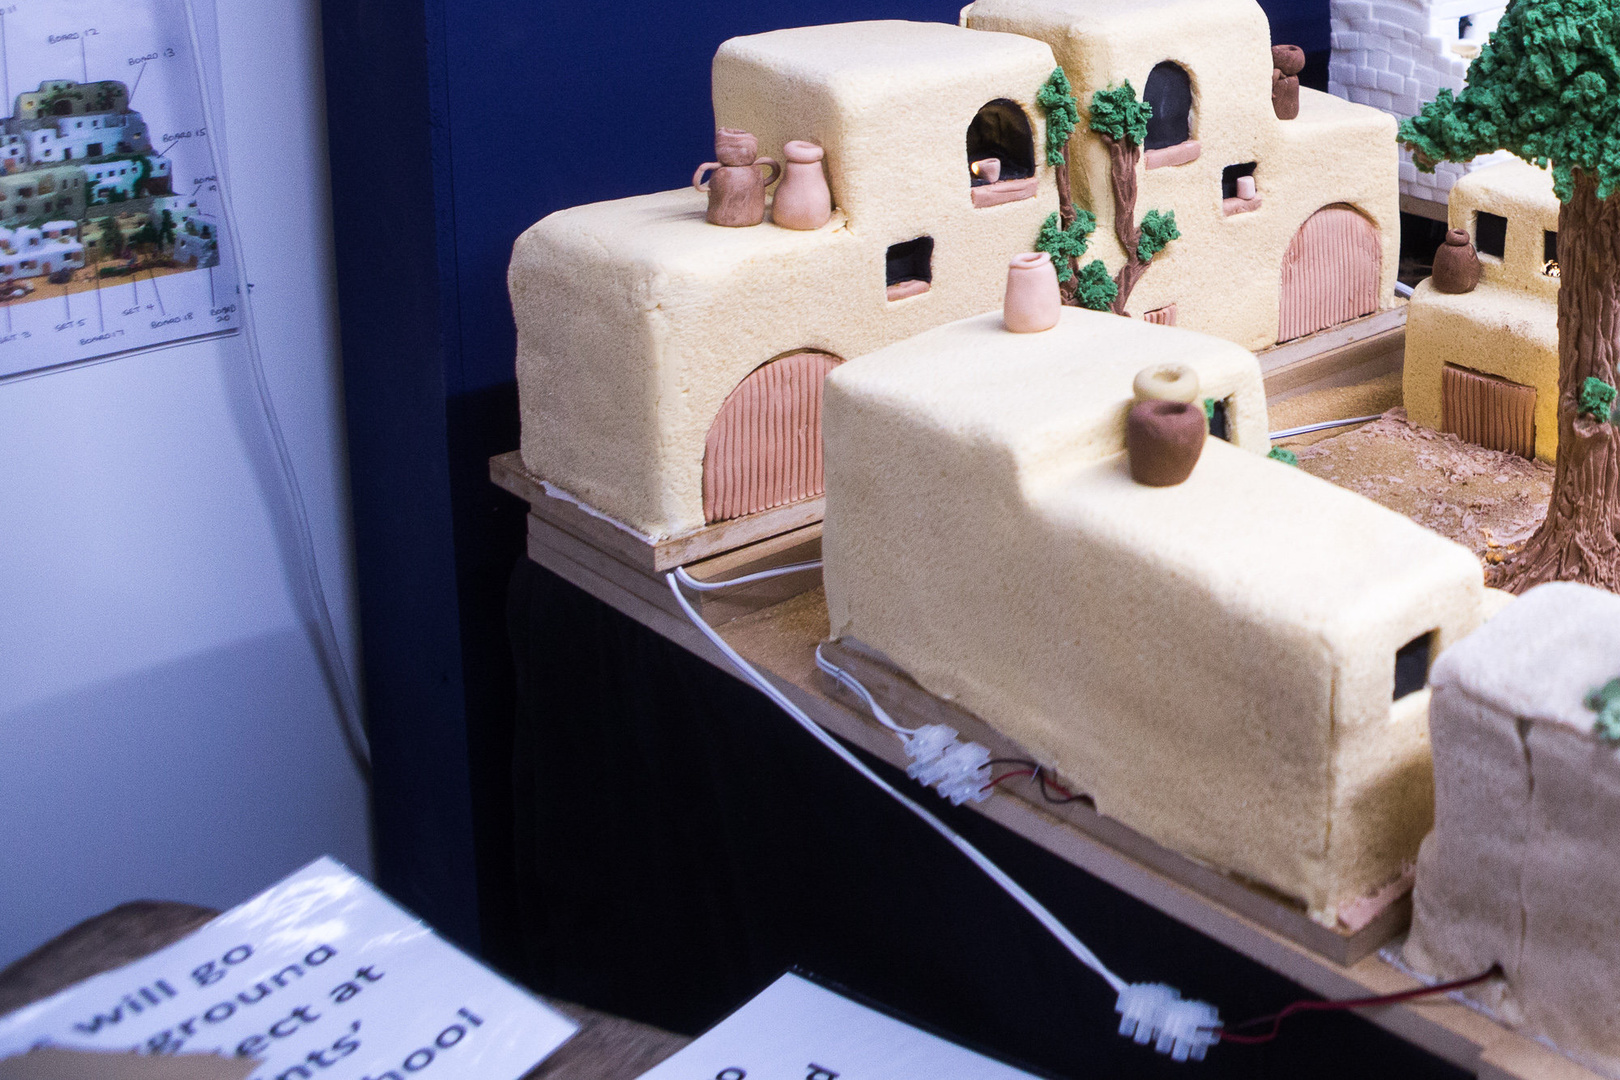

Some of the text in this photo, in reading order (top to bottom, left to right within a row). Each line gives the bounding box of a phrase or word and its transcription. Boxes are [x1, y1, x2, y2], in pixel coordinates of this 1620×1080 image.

[48, 32, 80, 44] BOARD
[128, 52, 159, 66] BOARD
[162, 130, 192, 143] BOARD
[210, 303, 237, 317] BOARD
[150, 316, 181, 329] BOARD
[73, 943, 255, 1035] will go
[329, 964, 386, 1004] at
